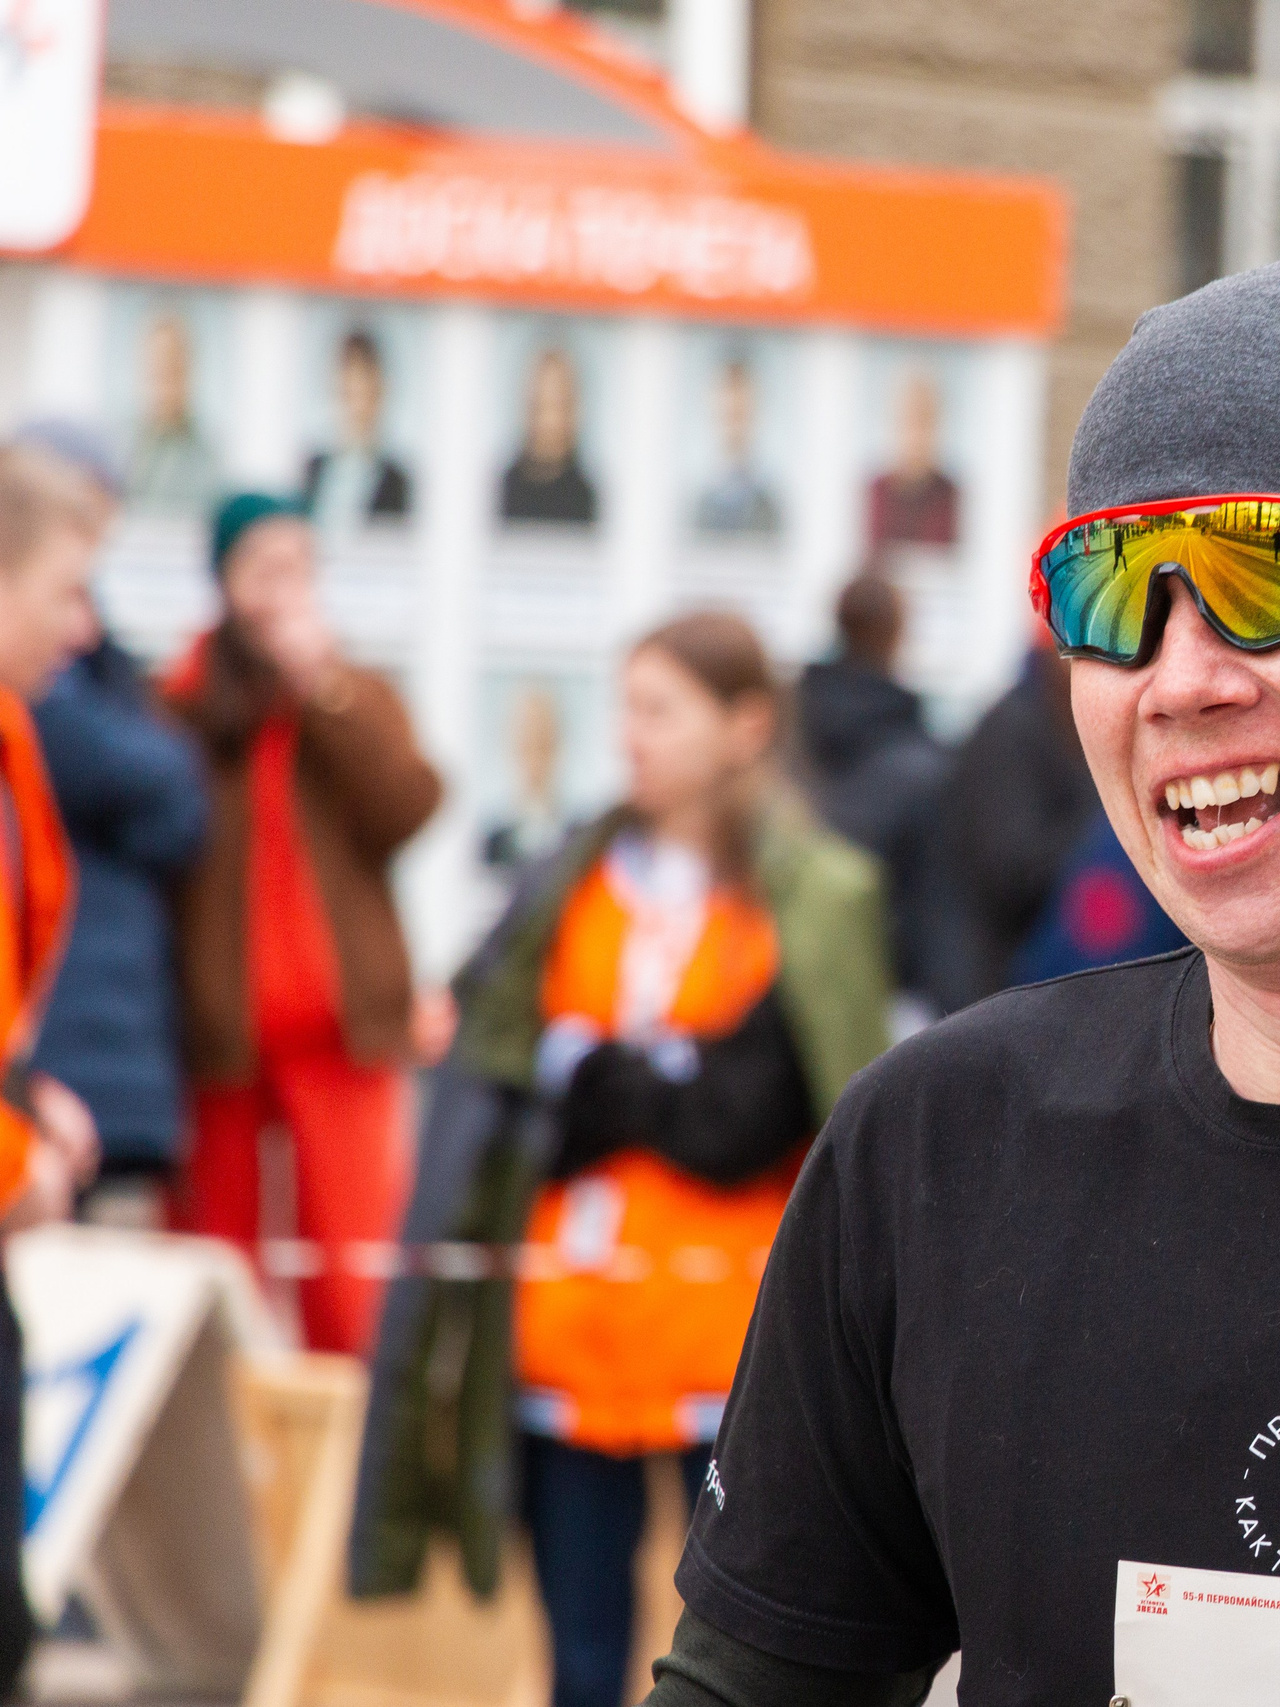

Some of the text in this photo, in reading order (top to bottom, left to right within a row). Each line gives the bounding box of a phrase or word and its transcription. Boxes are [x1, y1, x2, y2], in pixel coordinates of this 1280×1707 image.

[1235, 1496, 1273, 1558] КАК
[1182, 1591, 1204, 1602] 95-Я
[1136, 1604, 1168, 1615] ЗВЕЗДА
